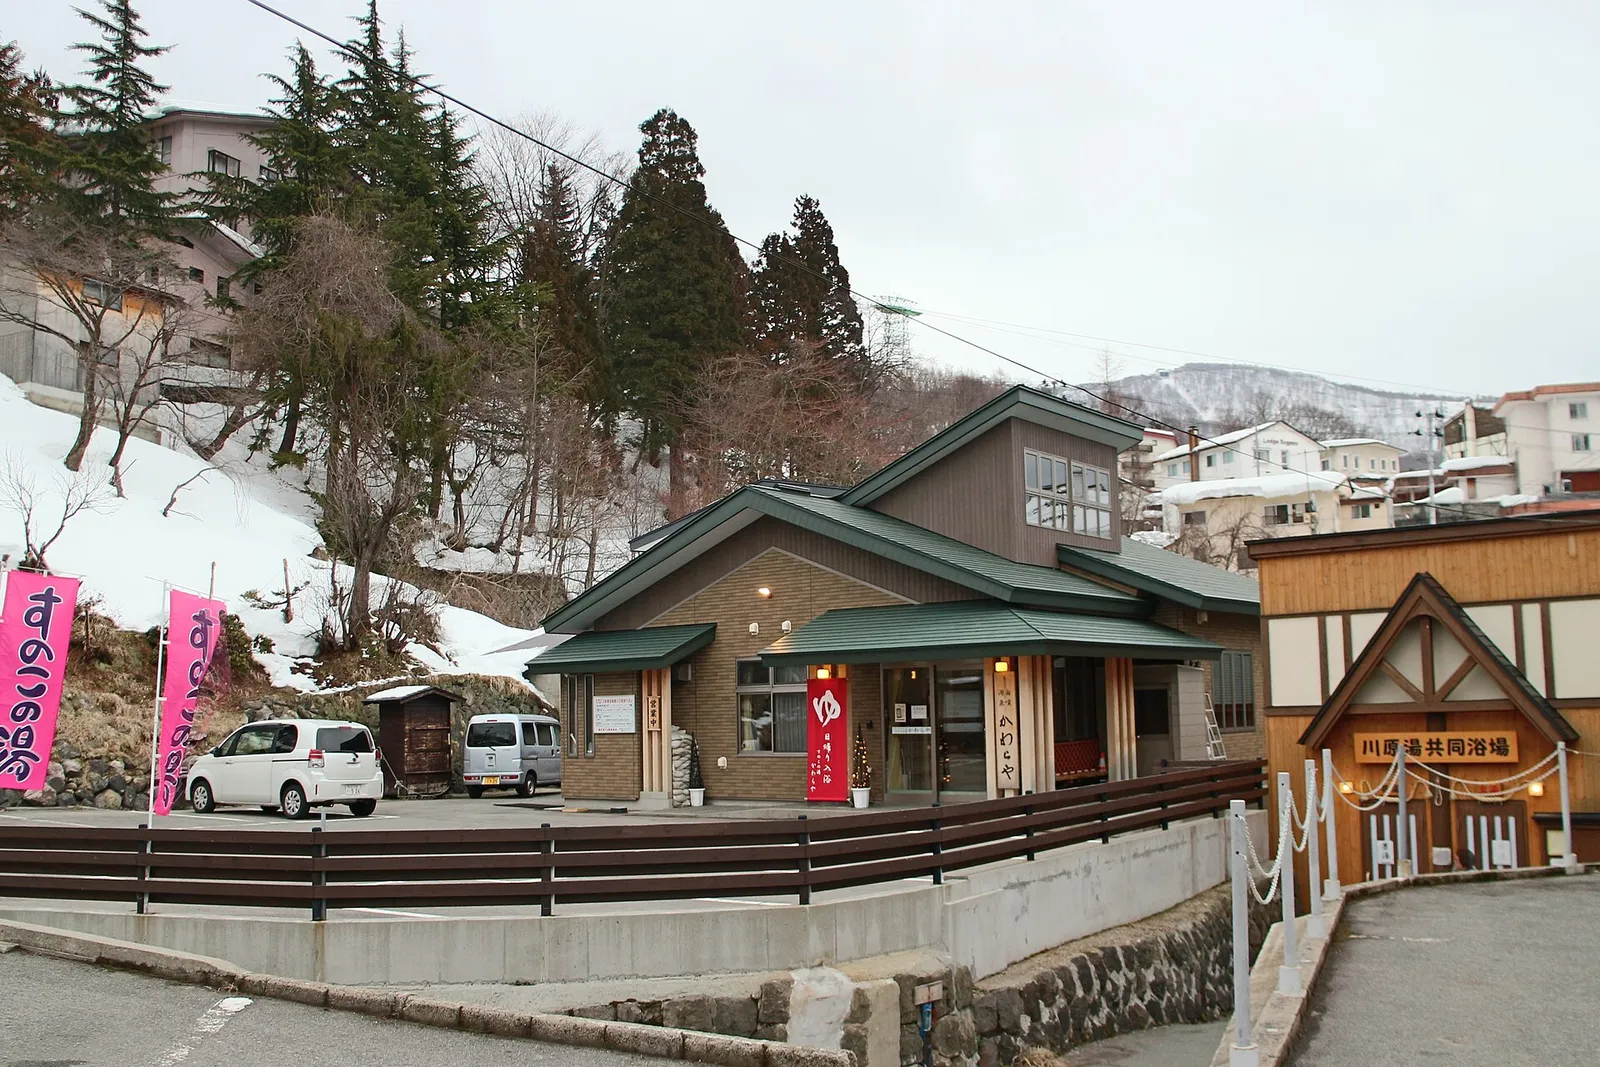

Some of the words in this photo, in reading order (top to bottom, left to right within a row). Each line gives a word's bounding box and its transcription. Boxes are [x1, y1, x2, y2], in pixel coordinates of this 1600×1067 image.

[812, 689, 842, 728] ゆ
[822, 732, 832, 784] 日帰り入浴
[999, 714, 1015, 780] かわらや
[1362, 737, 1510, 758] 川原湯共同浴場
